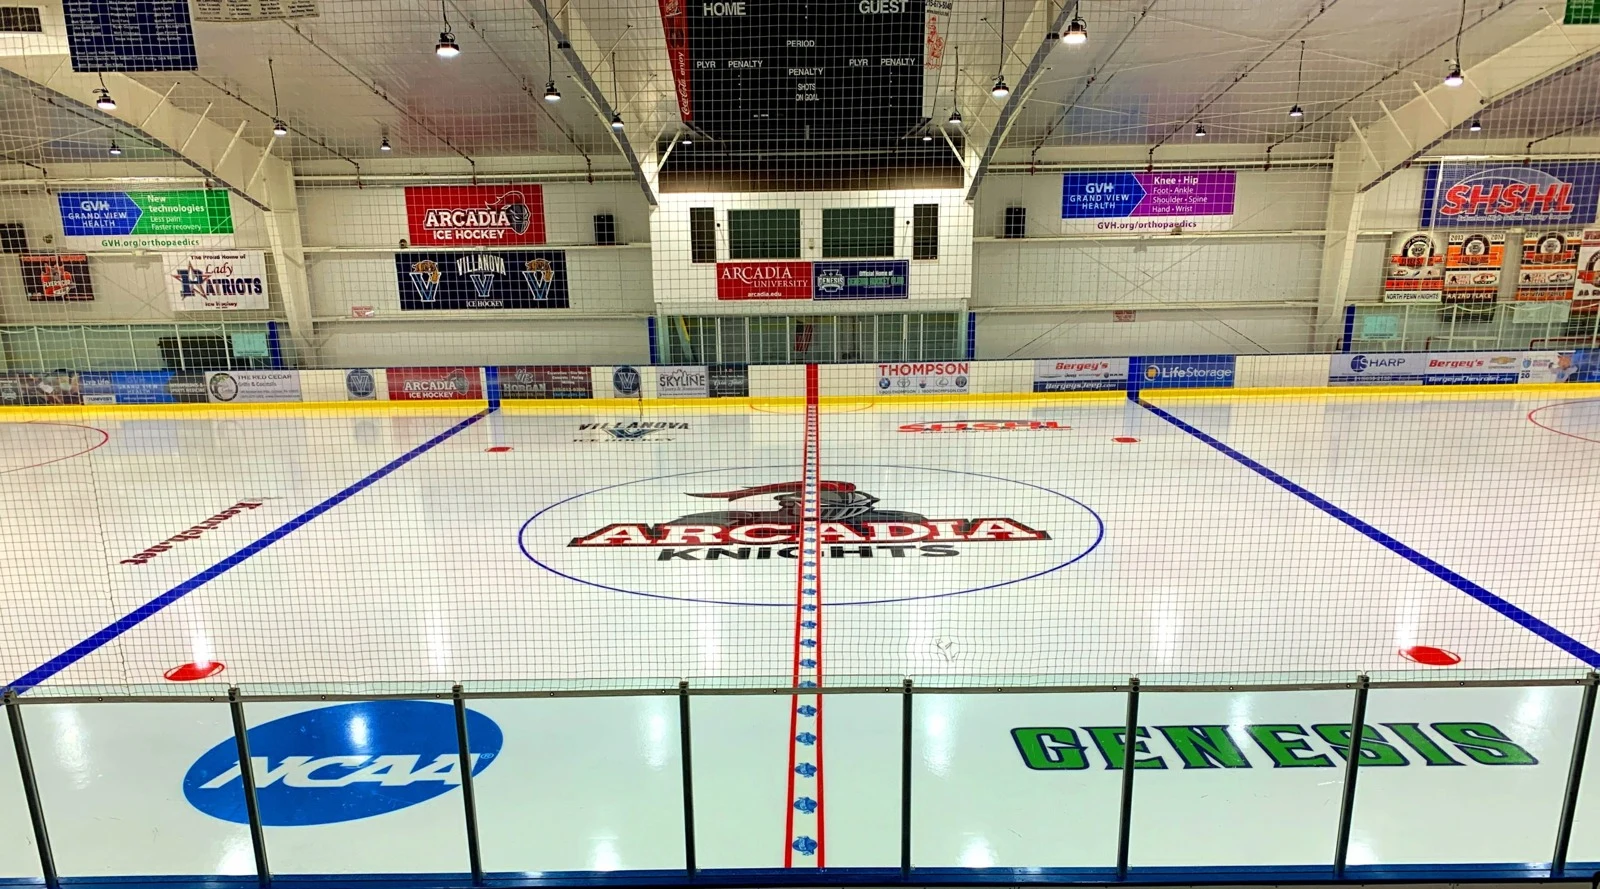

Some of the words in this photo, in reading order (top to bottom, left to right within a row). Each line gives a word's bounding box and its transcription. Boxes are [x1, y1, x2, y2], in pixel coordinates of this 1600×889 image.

[703, 2, 746, 16] HOME
[859, 0, 908, 14] GUEST
[728, 60, 763, 68] PENALTY
[1154, 177, 1176, 185] Knee
[1183, 176, 1199, 185] Hip
[1086, 183, 1114, 193] GVH
[1174, 186, 1194, 194] Ankle
[147, 195, 166, 203] New
[1070, 194, 1102, 202] GRAND
[1106, 194, 1130, 202] VIEW
[1440, 183, 1575, 215] SHSHL
[81, 200, 110, 212] GVH
[149, 204, 205, 214] technologies
[1082, 202, 1116, 210] HEALTH
[1176, 205, 1193, 213] Wrist
[68, 212, 99, 220] GRAND
[167, 216, 181, 224] pain
[424, 209, 512, 229] ARCADIA
[82, 219, 115, 228] HEALTH
[172, 224, 201, 232] recovery
[1097, 220, 1197, 231] GVH.org/orthopaedics
[433, 230, 452, 239] ICE
[455, 229, 505, 239] HOCKEY
[101, 238, 200, 248] GVH.org/orthopaedics
[205, 262, 233, 277] Lady
[456, 254, 507, 276] VILLANOVA
[721, 267, 792, 284] ARCADIA
[754, 280, 808, 288] UNIVERSITY
[818, 277, 844, 285] GENESIS
[1056, 362, 1109, 371] Bergey's
[1429, 359, 1484, 368] Bergey's
[879, 363, 968, 376] THOMPSON
[1162, 367, 1232, 379] LifeStorage
[404, 381, 457, 391] ARCADIA
[660, 376, 705, 387] SKYLINE
[579, 422, 688, 430] VILLANOVA
[567, 518, 1053, 547] ARCADIA
[1010, 722, 1539, 771] GENESIS
[199, 753, 482, 789] NCAA
